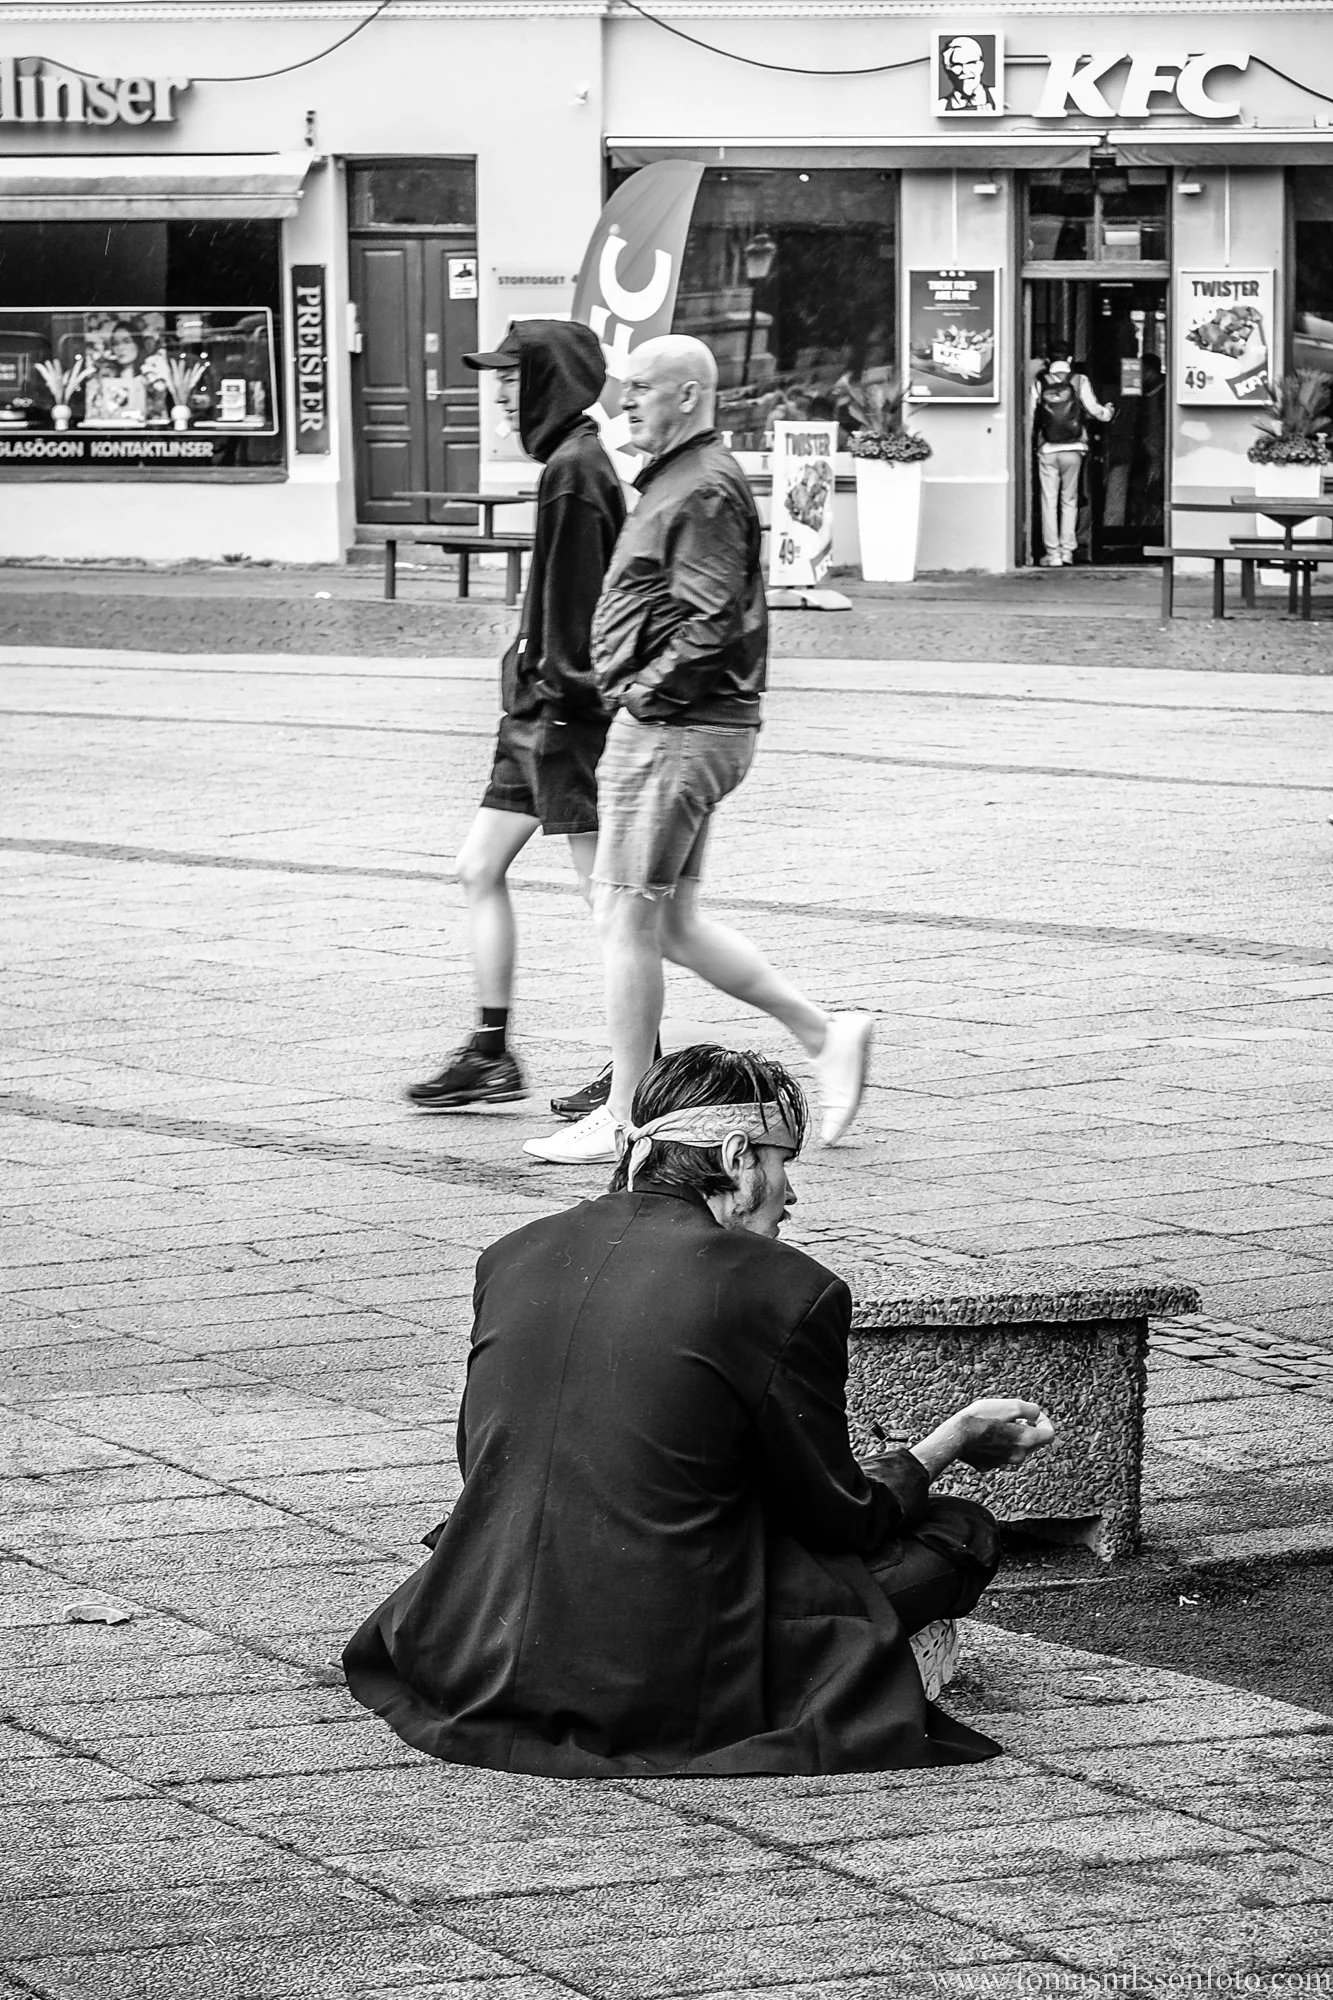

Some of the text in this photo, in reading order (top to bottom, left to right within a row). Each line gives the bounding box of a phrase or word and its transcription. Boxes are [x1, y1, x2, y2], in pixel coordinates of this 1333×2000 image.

[0, 57, 188, 125] linser
[1033, 51, 1250, 118] KFC
[498, 275, 566, 286] STORTORGET
[1192, 280, 1260, 300] TWISTER
[296, 284, 325, 434] PREISLER
[1185, 370, 1206, 389] 49
[90, 441, 214, 458] KONTAKTLINSER
[785, 432, 830, 457] TWISTER
[778, 538, 795, 565] 49
